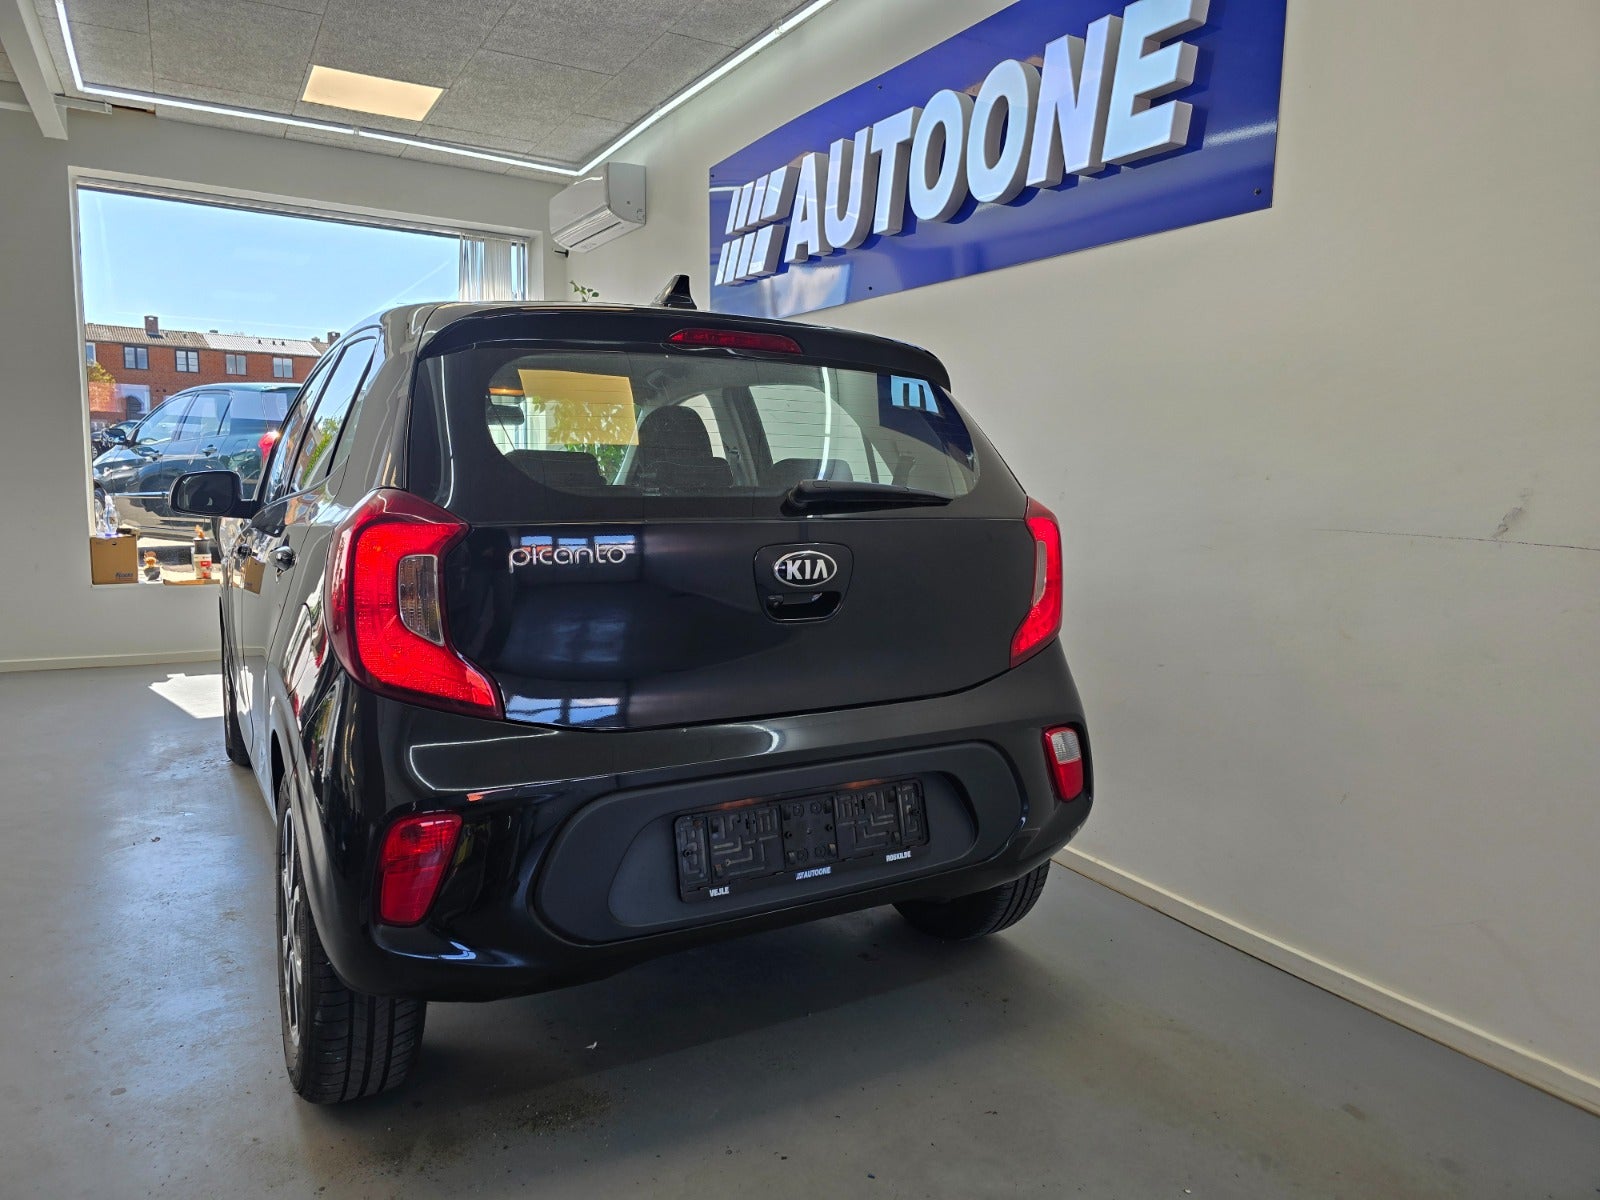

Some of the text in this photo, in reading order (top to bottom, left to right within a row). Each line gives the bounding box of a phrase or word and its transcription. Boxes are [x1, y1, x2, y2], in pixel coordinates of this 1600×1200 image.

[784, 0, 1207, 264] AUTOONE
[508, 543, 627, 573] picanto
[785, 559, 829, 581] KIA
[709, 886, 730, 898] VEJLE
[803, 866, 831, 879] AUTOONE
